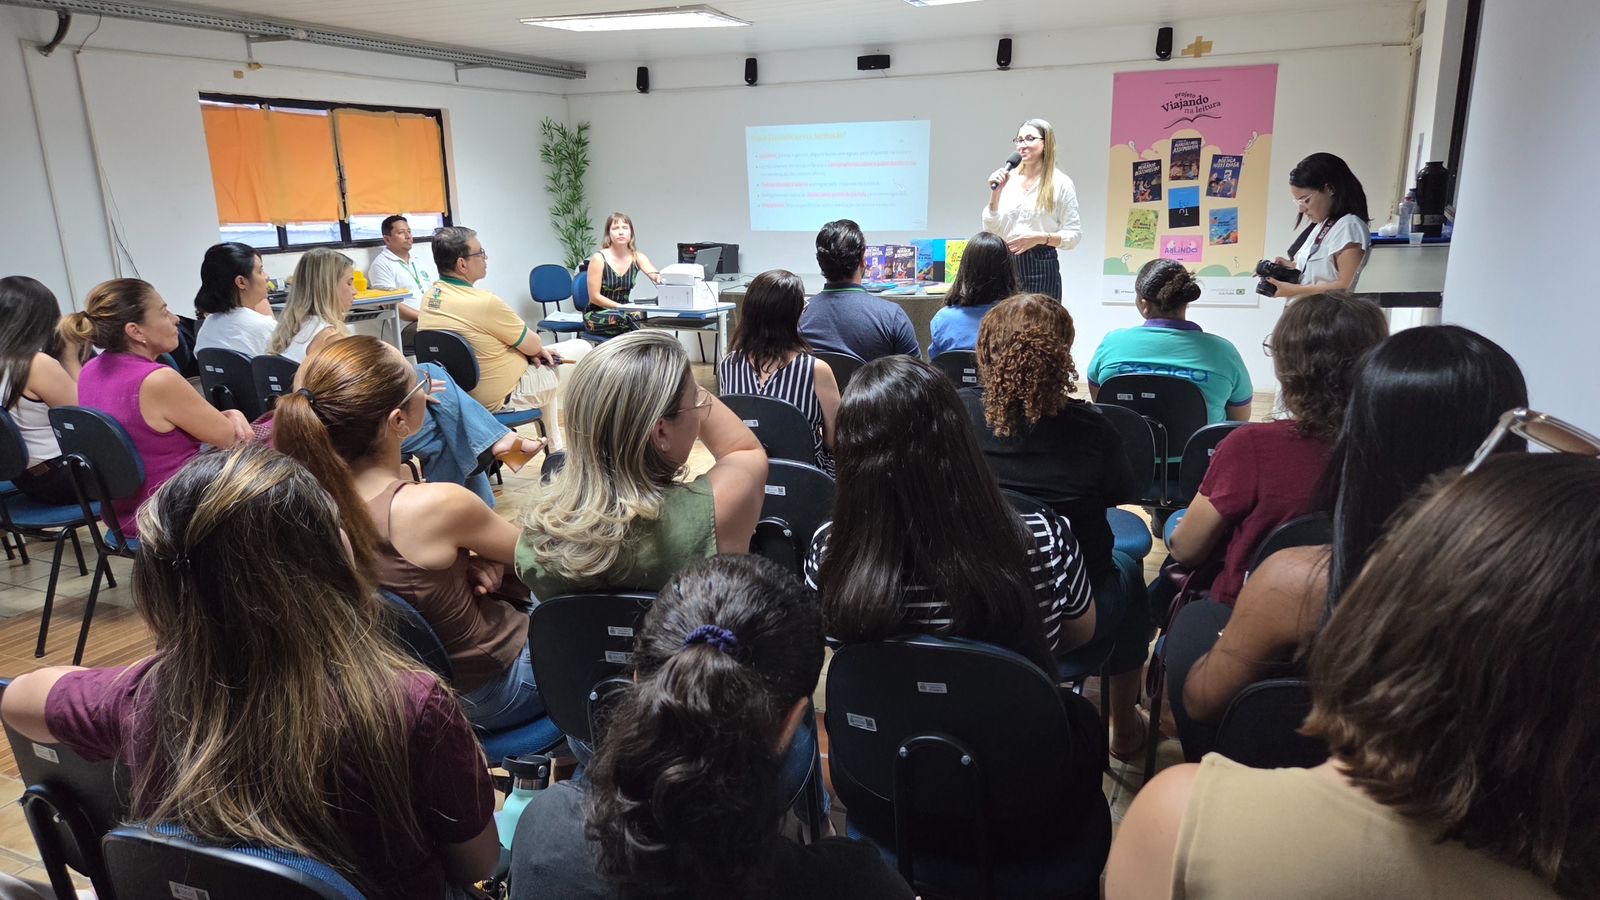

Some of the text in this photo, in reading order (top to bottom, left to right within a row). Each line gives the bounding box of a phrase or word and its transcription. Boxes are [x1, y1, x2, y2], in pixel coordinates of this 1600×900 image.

[1174, 91, 1196, 99] projeto
[1161, 94, 1209, 112] Viajando
[1196, 101, 1221, 113] leitura
